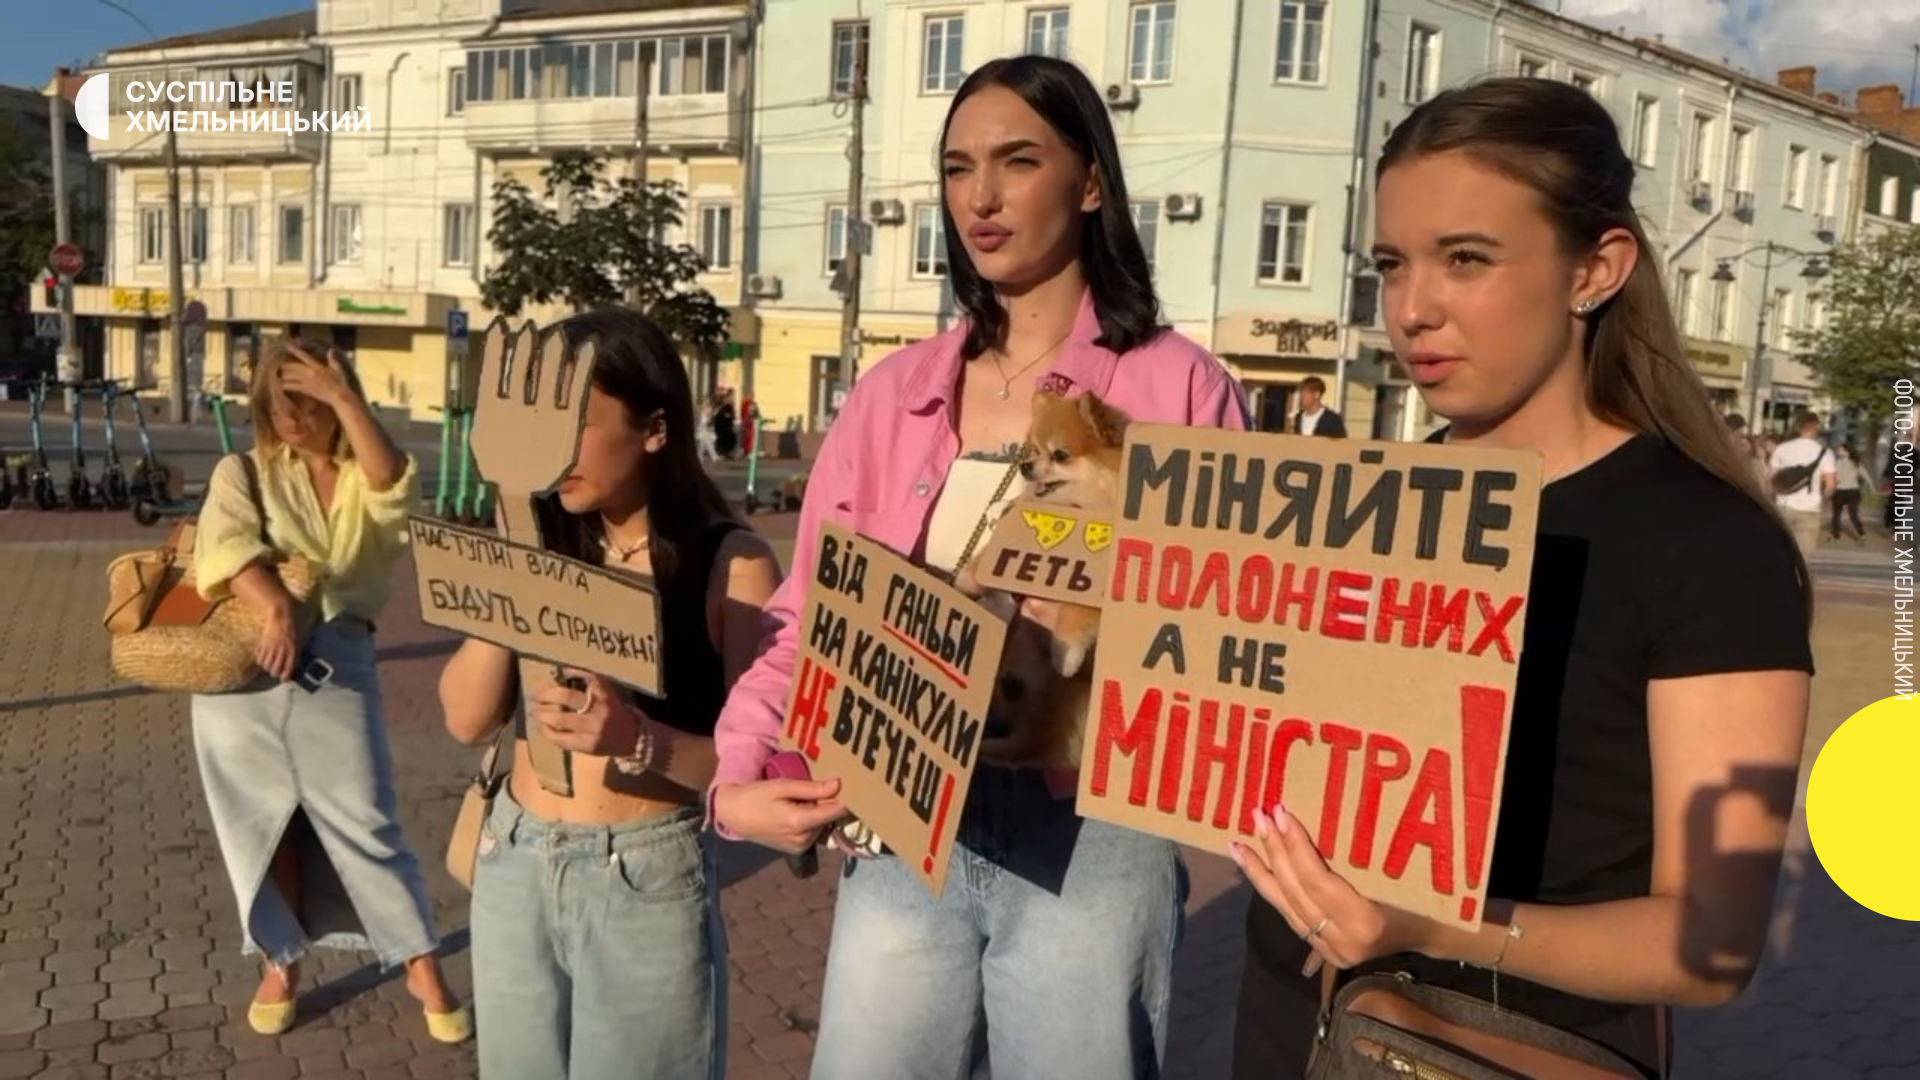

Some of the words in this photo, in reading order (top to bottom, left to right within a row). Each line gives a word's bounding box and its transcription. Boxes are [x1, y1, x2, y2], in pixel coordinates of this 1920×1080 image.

[413, 522, 514, 569] НАСТУПНІ
[991, 547, 1093, 592] ГЕТЬ
[428, 578, 532, 634] БУДУТЬ
[538, 606, 656, 664] СПРАВЖНІ
[810, 602, 848, 668] НА
[882, 573, 980, 677] ГАНЬБИ
[1110, 537, 1526, 665] ПОЛОНЕНИХ
[1141, 623, 1186, 675] А
[1217, 635, 1288, 695] НЕ
[786, 656, 837, 762] НЕ
